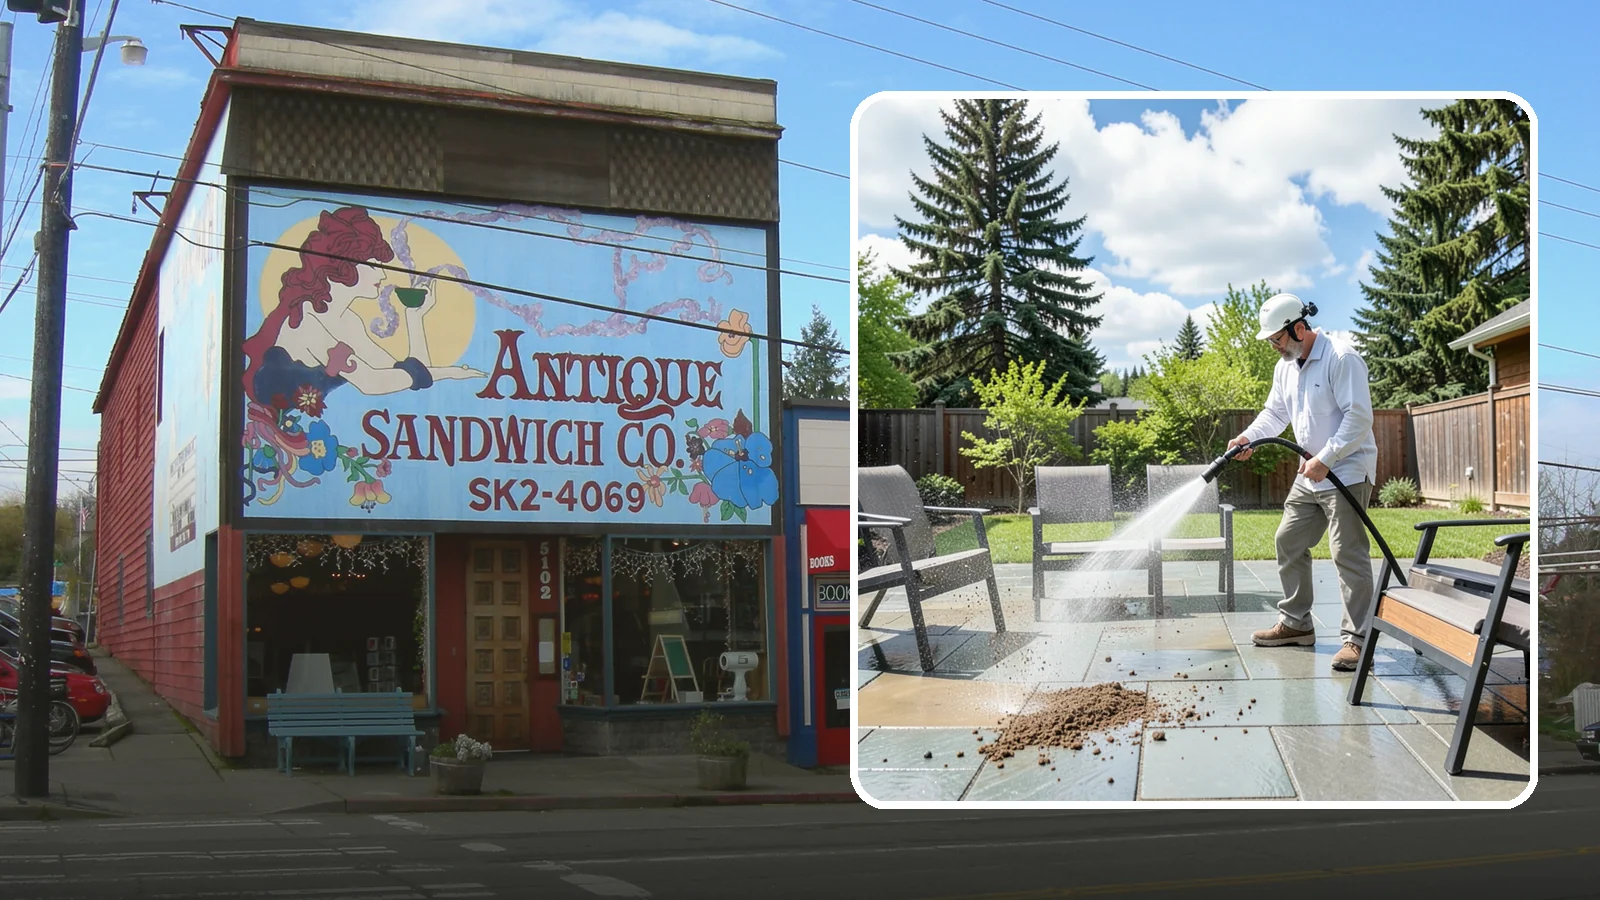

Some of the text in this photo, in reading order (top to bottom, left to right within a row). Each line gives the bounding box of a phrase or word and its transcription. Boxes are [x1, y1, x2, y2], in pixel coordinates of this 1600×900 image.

[475, 329, 723, 421] ANTIQUE
[361, 409, 685, 470] SANDWICH CO.
[469, 477, 645, 513] SK2-4069
[539, 541, 551, 599] 5102
[809, 555, 834, 568] BOOKS
